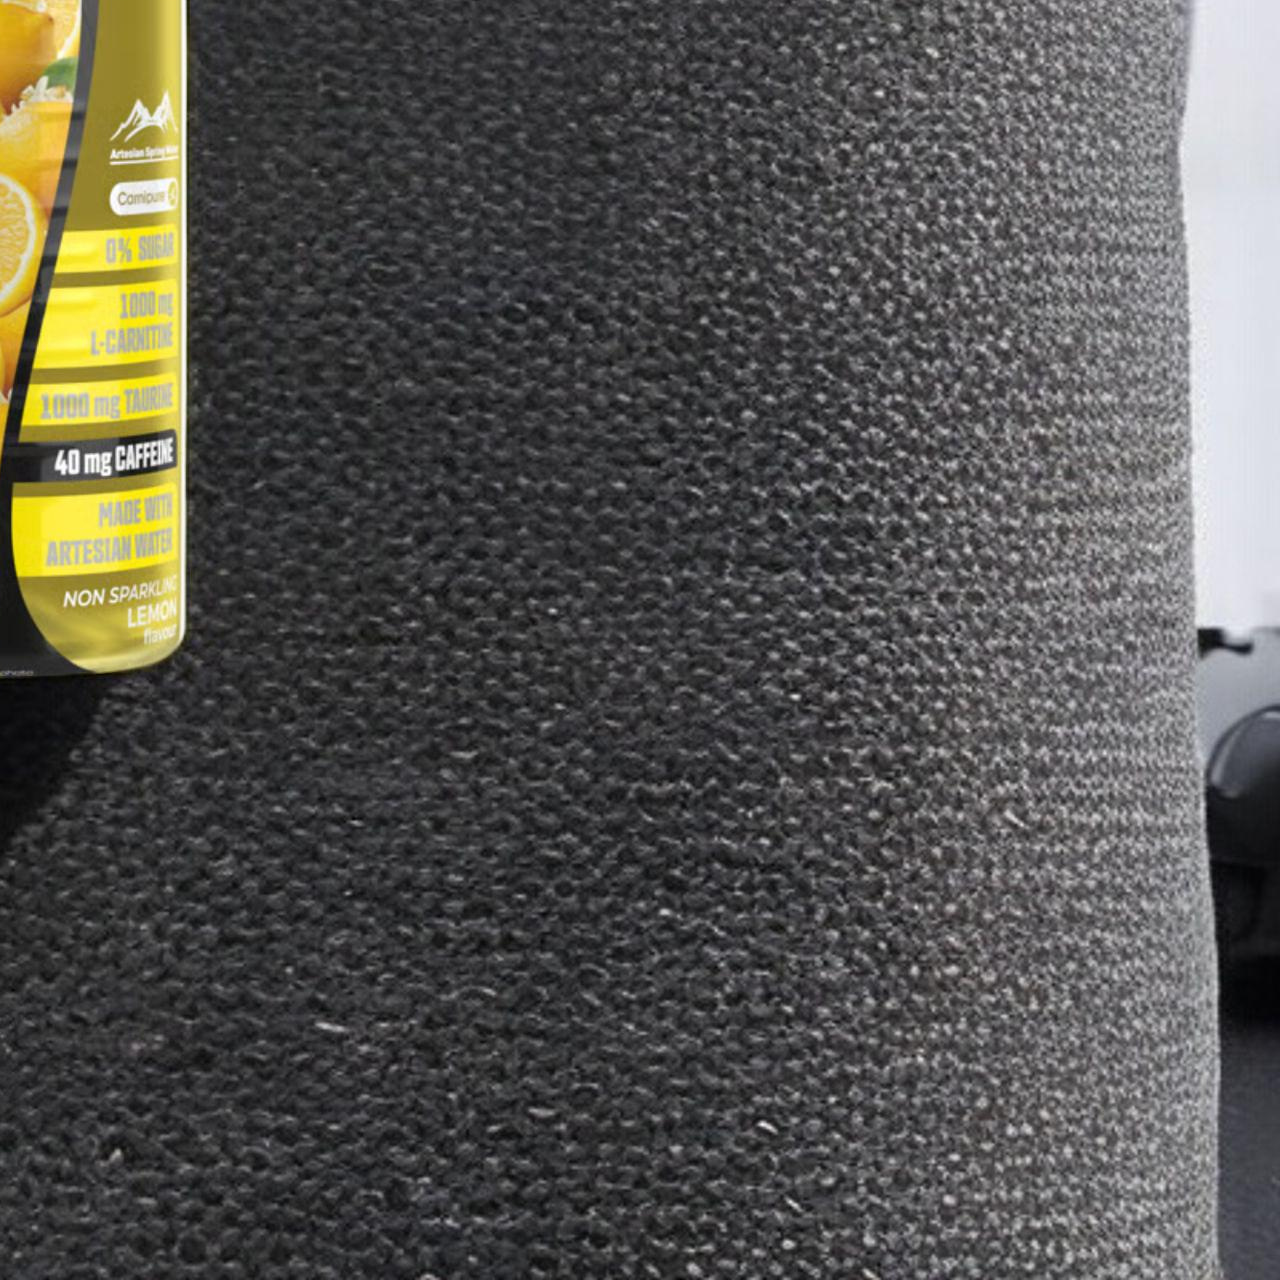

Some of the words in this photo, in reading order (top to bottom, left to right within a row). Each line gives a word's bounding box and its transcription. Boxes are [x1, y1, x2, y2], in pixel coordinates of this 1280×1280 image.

[105, 236, 132, 264] 0%
[138, 232, 175, 261] SUGAR
[120, 291, 156, 319] 1000
[91, 322, 174, 356] L-CARNITINE
[40, 393, 90, 420] 1000
[94, 395, 120, 419] mg
[124, 383, 174, 414] TAURINE
[54, 449, 80, 475] 40
[84, 452, 112, 477] mg
[115, 437, 174, 471] CAFFEINE
[98, 499, 141, 528] MADE
[145, 493, 174, 521] WITH
[46, 535, 131, 567] ARTESIAN
[134, 528, 174, 558] WATER
[63, 588, 106, 608] NON
[127, 597, 177, 628] LEMON
